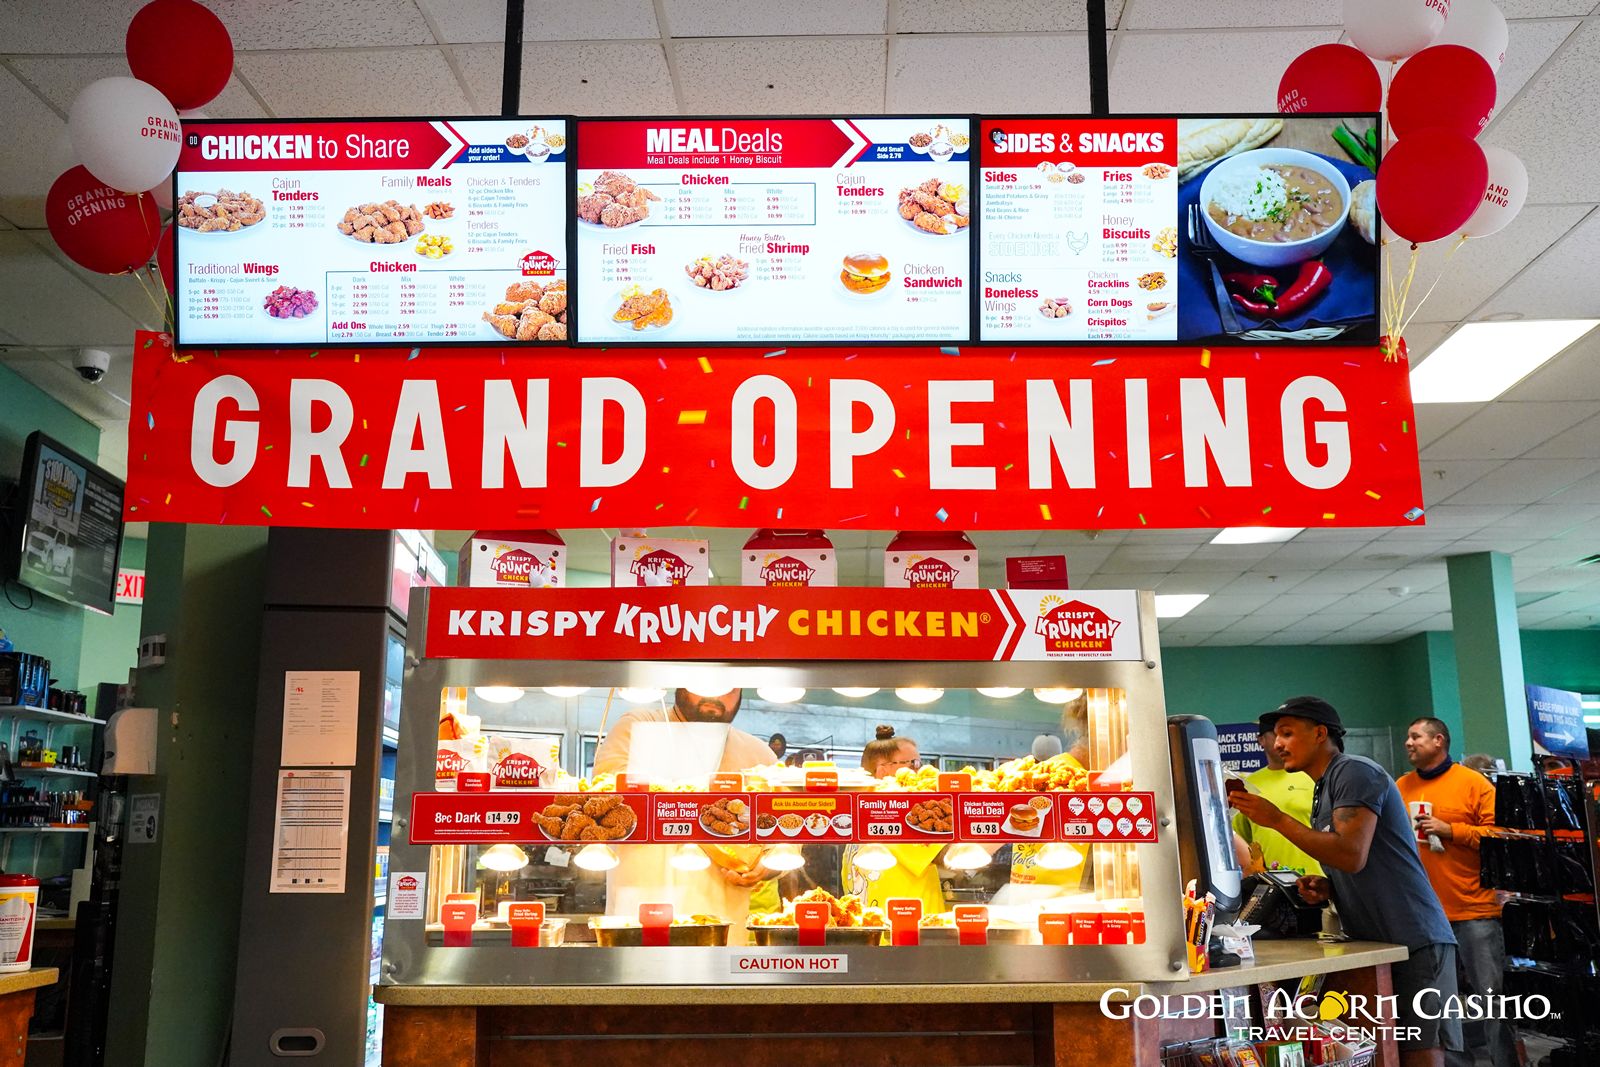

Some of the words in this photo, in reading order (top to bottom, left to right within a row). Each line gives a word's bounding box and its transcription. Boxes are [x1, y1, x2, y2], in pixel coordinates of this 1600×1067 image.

[147, 116, 179, 131] GRAND
[140, 127, 182, 144] OPENING
[646, 128, 719, 152] MEAL
[721, 127, 783, 153] Deals
[201, 134, 313, 160] CHICKEN
[316, 136, 339, 159] to
[345, 133, 409, 159] Share
[994, 132, 1055, 153] SIDES
[1059, 133, 1074, 153] &
[1078, 132, 1164, 153] SNACKS
[647, 155, 666, 164] Meal
[668, 155, 690, 164] Deals
[722, 155, 727, 164] 1
[729, 155, 753, 166] Honey
[755, 155, 782, 164] Biscuit
[381, 176, 414, 188] Family
[416, 175, 452, 187] Meals
[466, 177, 498, 187] Chicken
[500, 178, 507, 186] &
[508, 176, 541, 187] Tenders
[682, 174, 729, 185] Chicken
[836, 173, 866, 186] Cajun
[985, 171, 1017, 182] Sides
[1103, 170, 1133, 182] Fries
[272, 177, 301, 192] Cajun
[1488, 183, 1509, 196] AND
[272, 190, 319, 201] Tenders
[837, 185, 884, 197] Tenders
[67, 187, 115, 211] GRAND
[1484, 192, 1509, 208] NING
[67, 198, 126, 226] OPENING
[466, 220, 499, 230] Tenders
[1102, 214, 1134, 227] Honey
[739, 233, 762, 243] Honey
[764, 233, 786, 242] Butter
[1103, 228, 1150, 239] Biscuits
[602, 243, 628, 255] Fried
[631, 243, 656, 255] Fish
[739, 242, 764, 254] Fried
[766, 242, 810, 256] Shrimp
[988, 241, 1059, 256] SIDEKICK
[188, 263, 240, 275] Traditional
[243, 262, 279, 276] Wings
[370, 261, 417, 273] Chicken
[517, 258, 560, 271] KRUNCHY
[904, 263, 945, 275] Chicken
[985, 271, 1022, 283] Snacks
[1087, 271, 1118, 279] Chicken
[904, 276, 963, 288] Sandwich
[1087, 279, 1130, 288] Cracklins
[985, 287, 1039, 298] Boneless
[985, 300, 1016, 314] Wings
[1087, 298, 1108, 307] Corn
[1111, 298, 1133, 308] Dogs
[332, 321, 348, 330] Add
[350, 321, 367, 330] Ons
[1087, 317, 1127, 328] Crispitos
[191, 374, 647, 490] GRAND
[730, 374, 1352, 490] OPENING
[502, 574, 529, 582] CHICKE
[760, 566, 816, 582] KRUNCHY
[904, 567, 960, 582] KRUNCHY
[116, 573, 146, 598] EXIT
[1057, 611, 1096, 619] KRISPY
[448, 609, 605, 637] KRISPY
[613, 602, 780, 643] KRUNCHY
[1035, 615, 1121, 640] KRUNCHY
[1055, 640, 1105, 649] CHICKEN
[1219, 744, 1241, 753] ORTED
[1243, 743, 1265, 752] SNAC
[436, 758, 470, 772] NCHY
[506, 758, 531, 766] KRISPY
[1242, 760, 1260, 768] EACH
[492, 762, 547, 780] KRUNCHY
[859, 800, 887, 811] Family
[889, 800, 909, 809] Meal
[964, 806, 985, 815] Meal
[986, 806, 1005, 815] Deal
[455, 811, 481, 824] Dark
[657, 808, 678, 817] Meal
[679, 808, 699, 817] Deal
[739, 957, 805, 970] CAUTION
[809, 957, 839, 970] HOT
